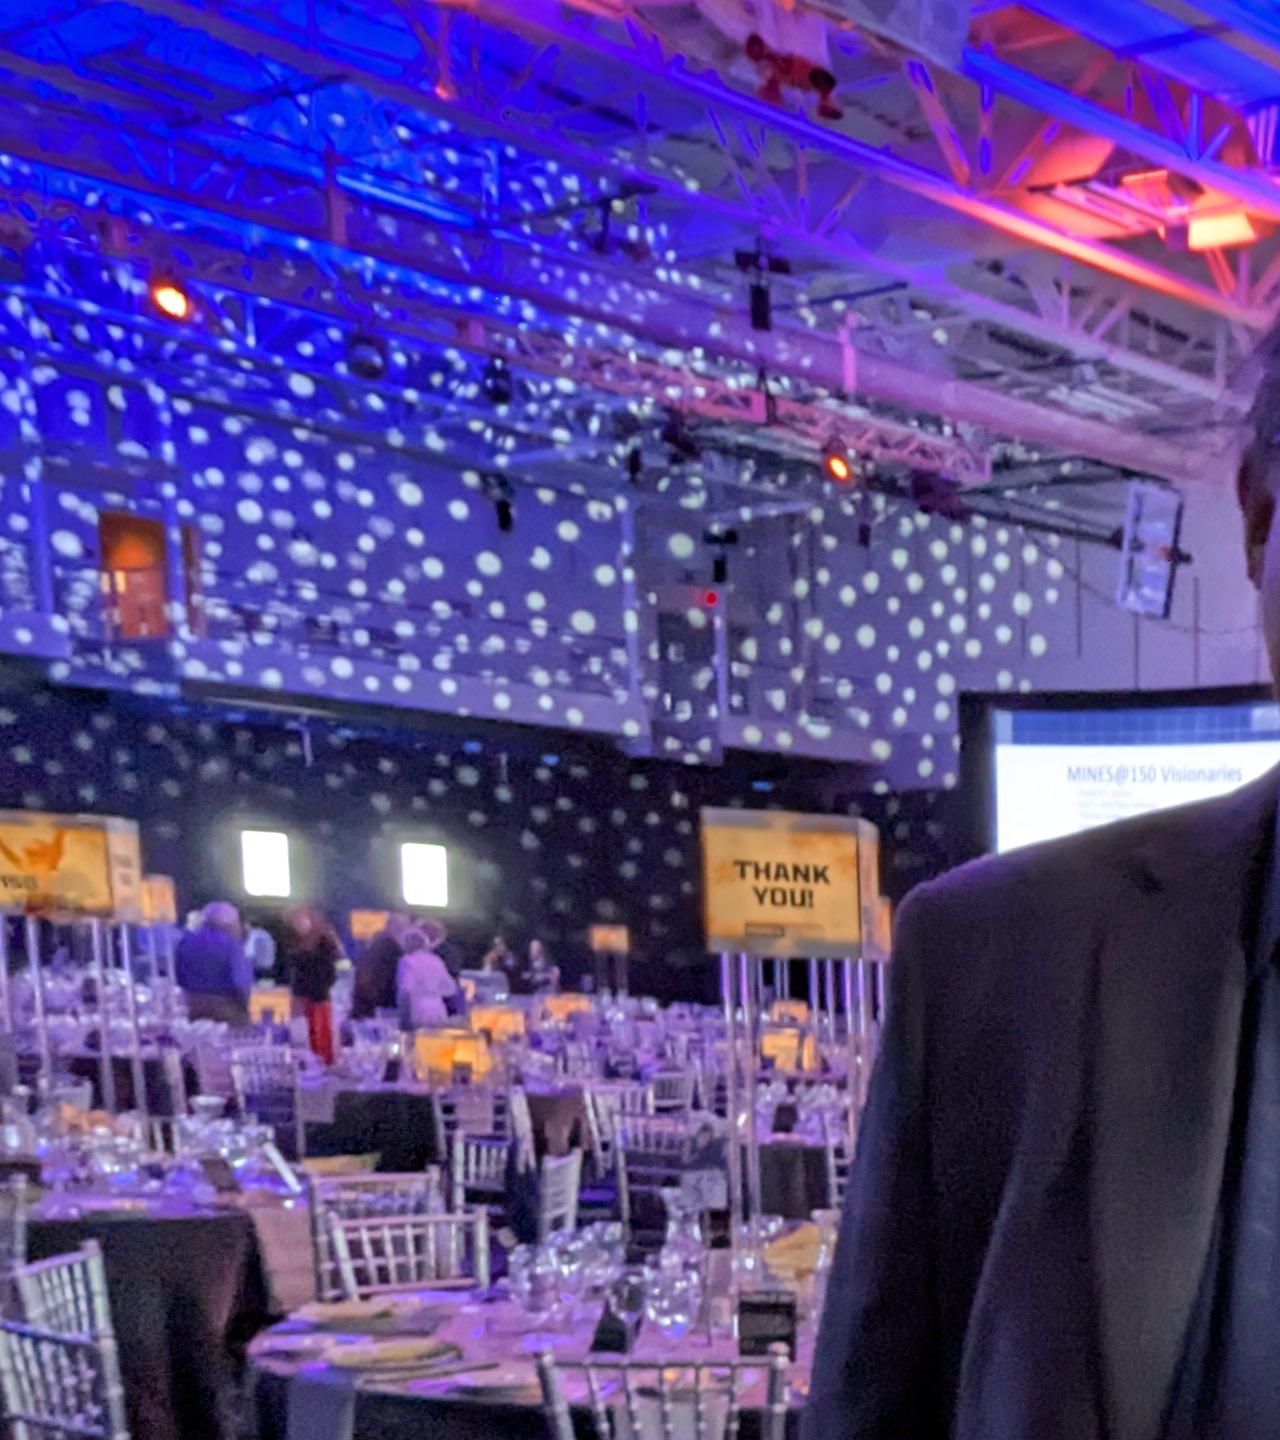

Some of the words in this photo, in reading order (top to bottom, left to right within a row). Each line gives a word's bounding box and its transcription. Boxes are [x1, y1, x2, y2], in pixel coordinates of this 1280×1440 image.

[1067, 765, 1156, 786] MINES@150
[1161, 764, 1243, 783] Visionaries
[733, 860, 831, 884] THANK
[753, 887, 814, 908] YOU!
